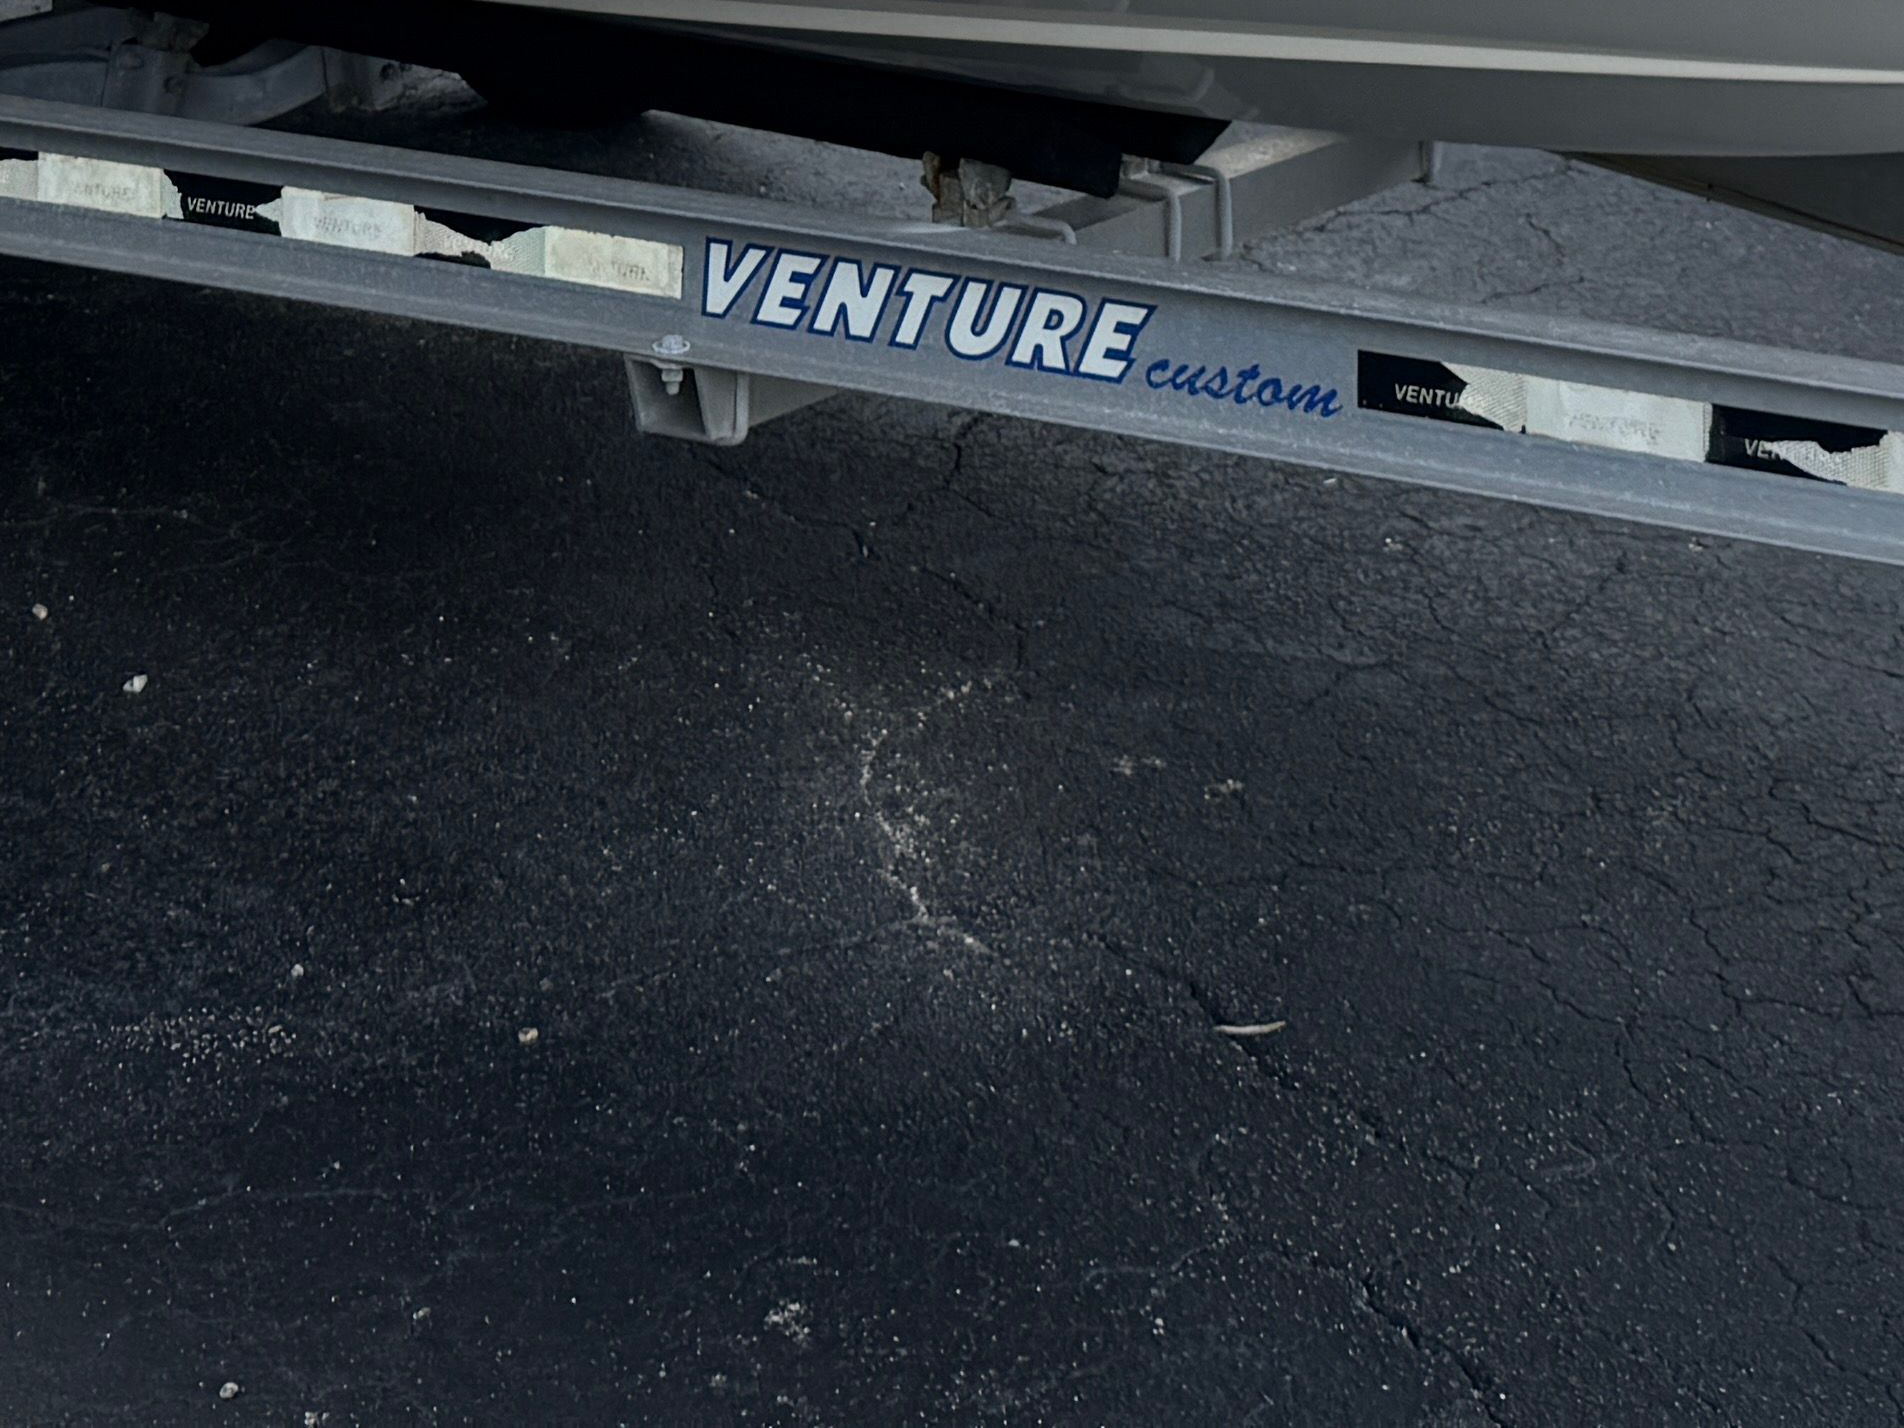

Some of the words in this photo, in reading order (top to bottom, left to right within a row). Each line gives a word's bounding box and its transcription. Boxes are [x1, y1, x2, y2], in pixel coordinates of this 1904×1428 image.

[187, 196, 256, 221] VENTURE
[701, 237, 1157, 384] VENTURE
[1144, 355, 1344, 418] custom
[1394, 383, 1468, 410] VENTU
